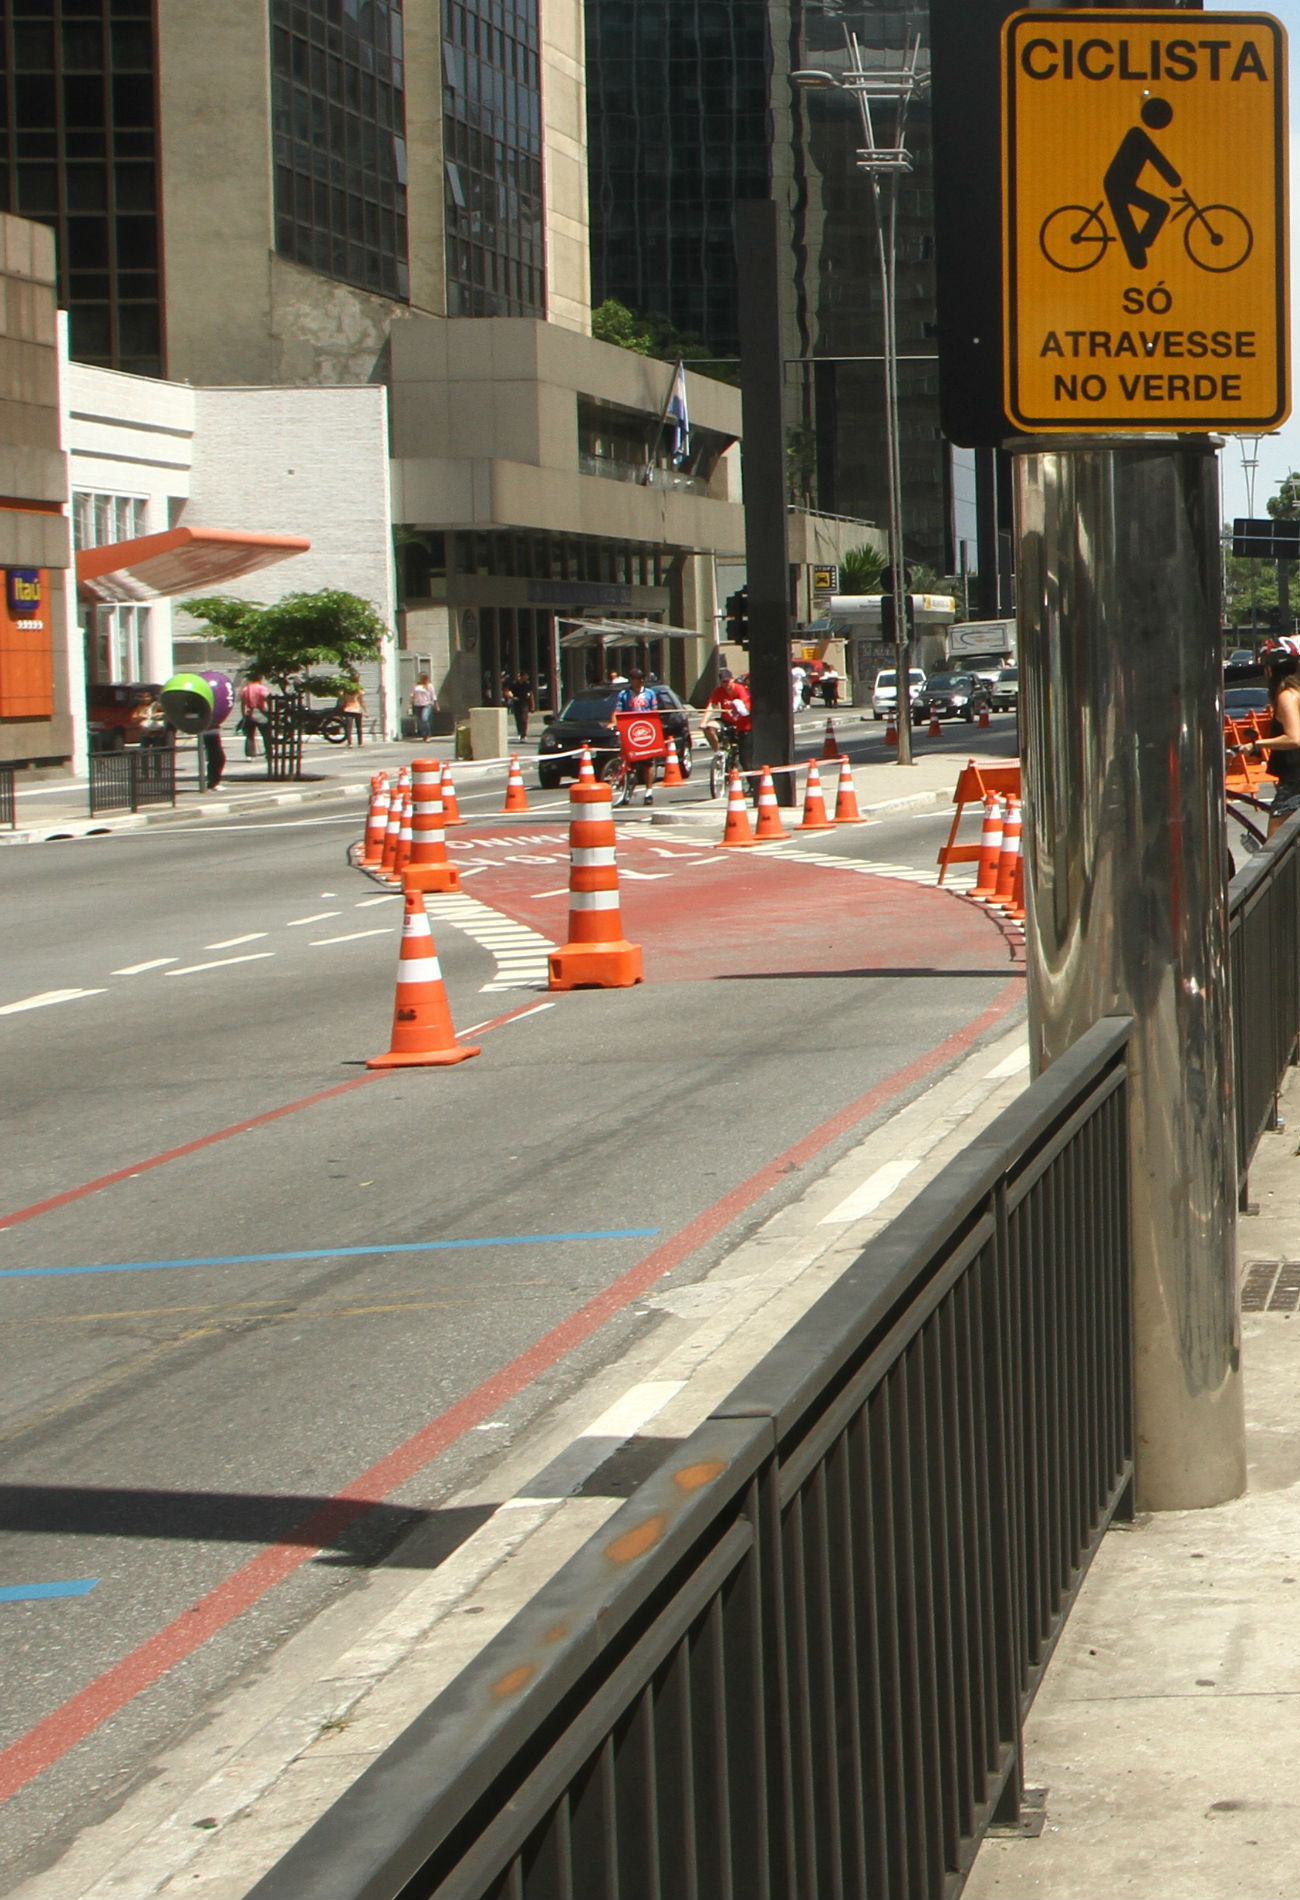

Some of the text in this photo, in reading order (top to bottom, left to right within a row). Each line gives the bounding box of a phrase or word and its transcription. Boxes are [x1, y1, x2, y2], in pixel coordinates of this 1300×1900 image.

[1021, 38, 1269, 82] CICLISTA
[1122, 281, 1173, 315] SÓ
[1039, 331, 1256, 359] ATRAVESSE
[1053, 374, 1242, 402] NO VERDE
[15, 577, 41, 601] Itaú
